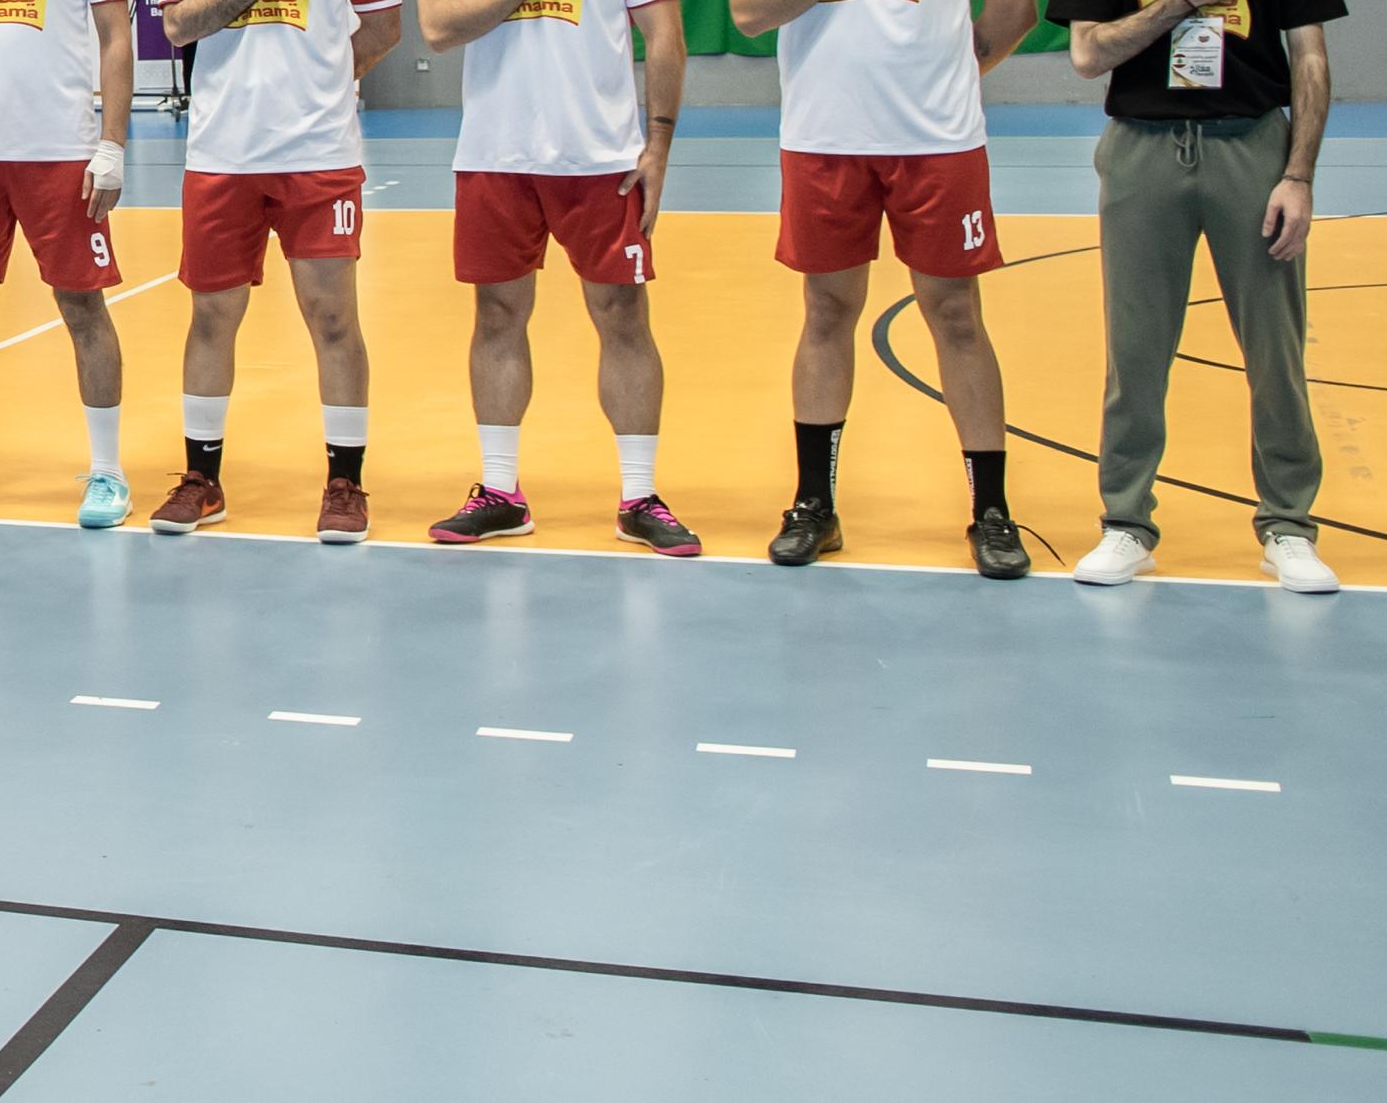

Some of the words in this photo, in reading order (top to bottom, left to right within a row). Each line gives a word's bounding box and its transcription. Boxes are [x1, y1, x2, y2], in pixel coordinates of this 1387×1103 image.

[332, 199, 356, 236] 10
[961, 210, 985, 251] 13
[90, 232, 111, 268] 9
[624, 244, 646, 284] 7
